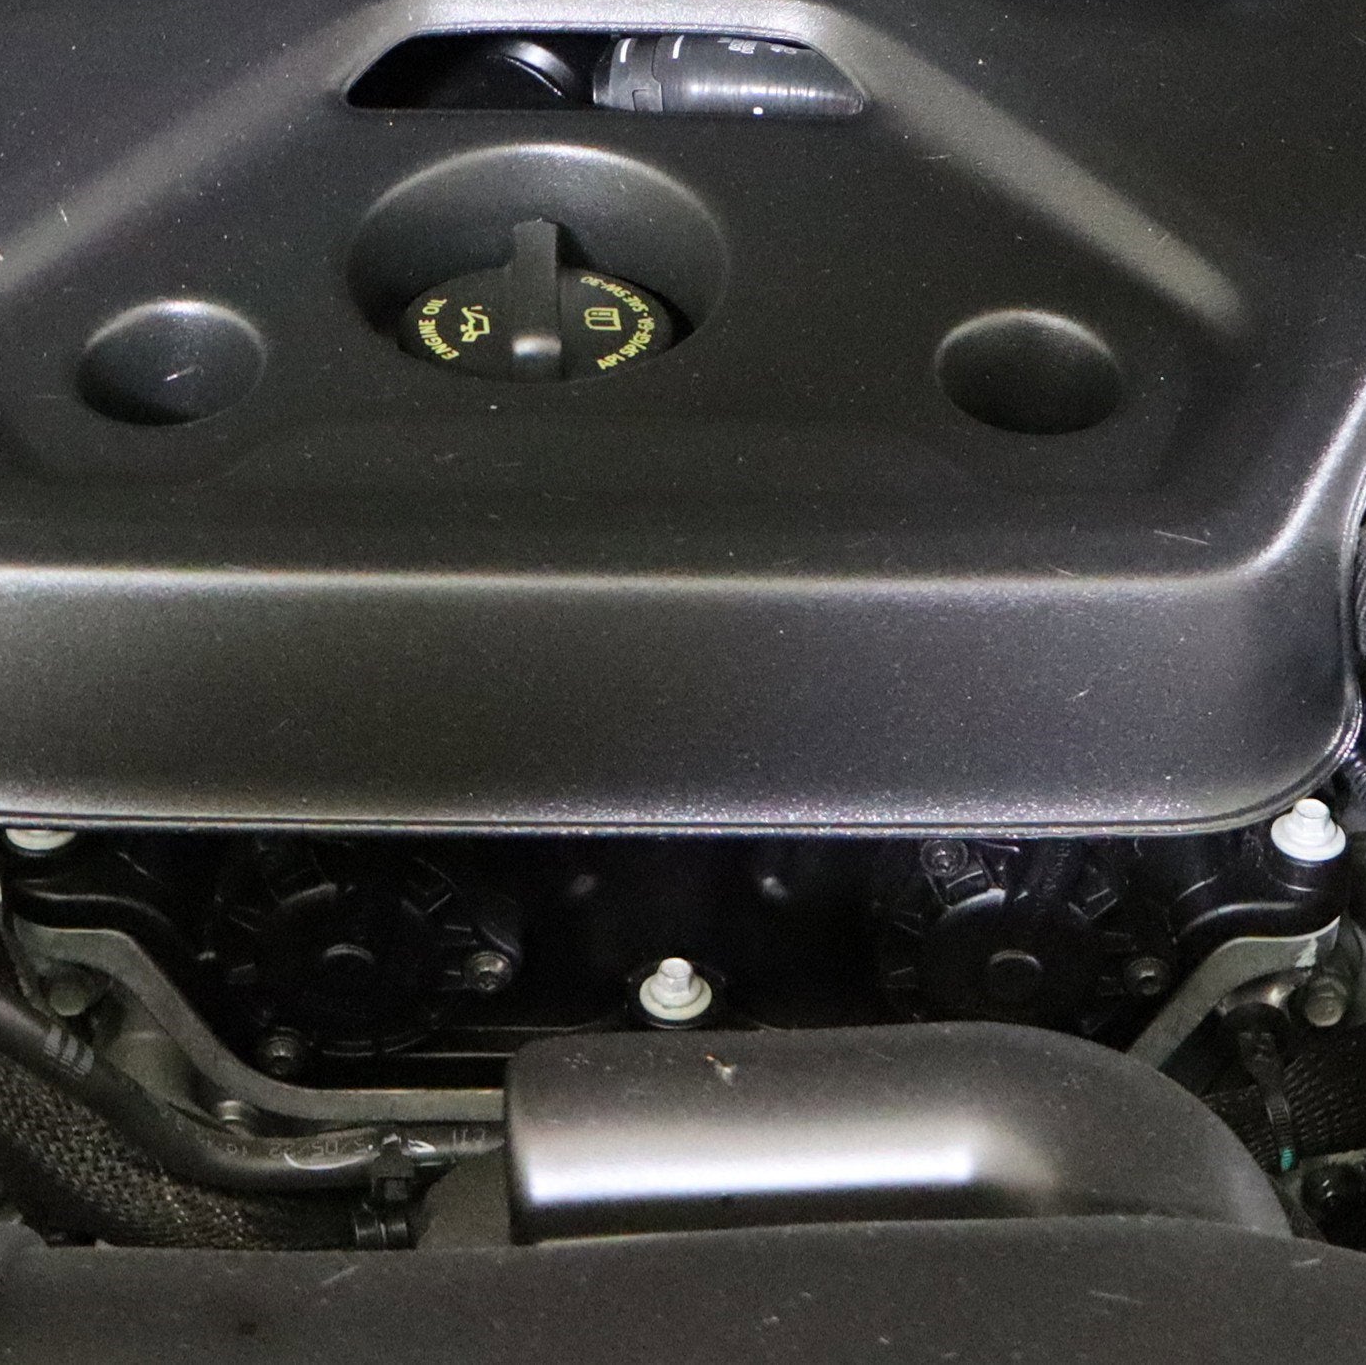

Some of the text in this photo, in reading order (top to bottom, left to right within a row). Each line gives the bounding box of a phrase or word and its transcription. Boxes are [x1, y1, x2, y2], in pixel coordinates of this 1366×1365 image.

[418, 298, 460, 360] ENGINE OIL
[597, 353, 626, 370] API
